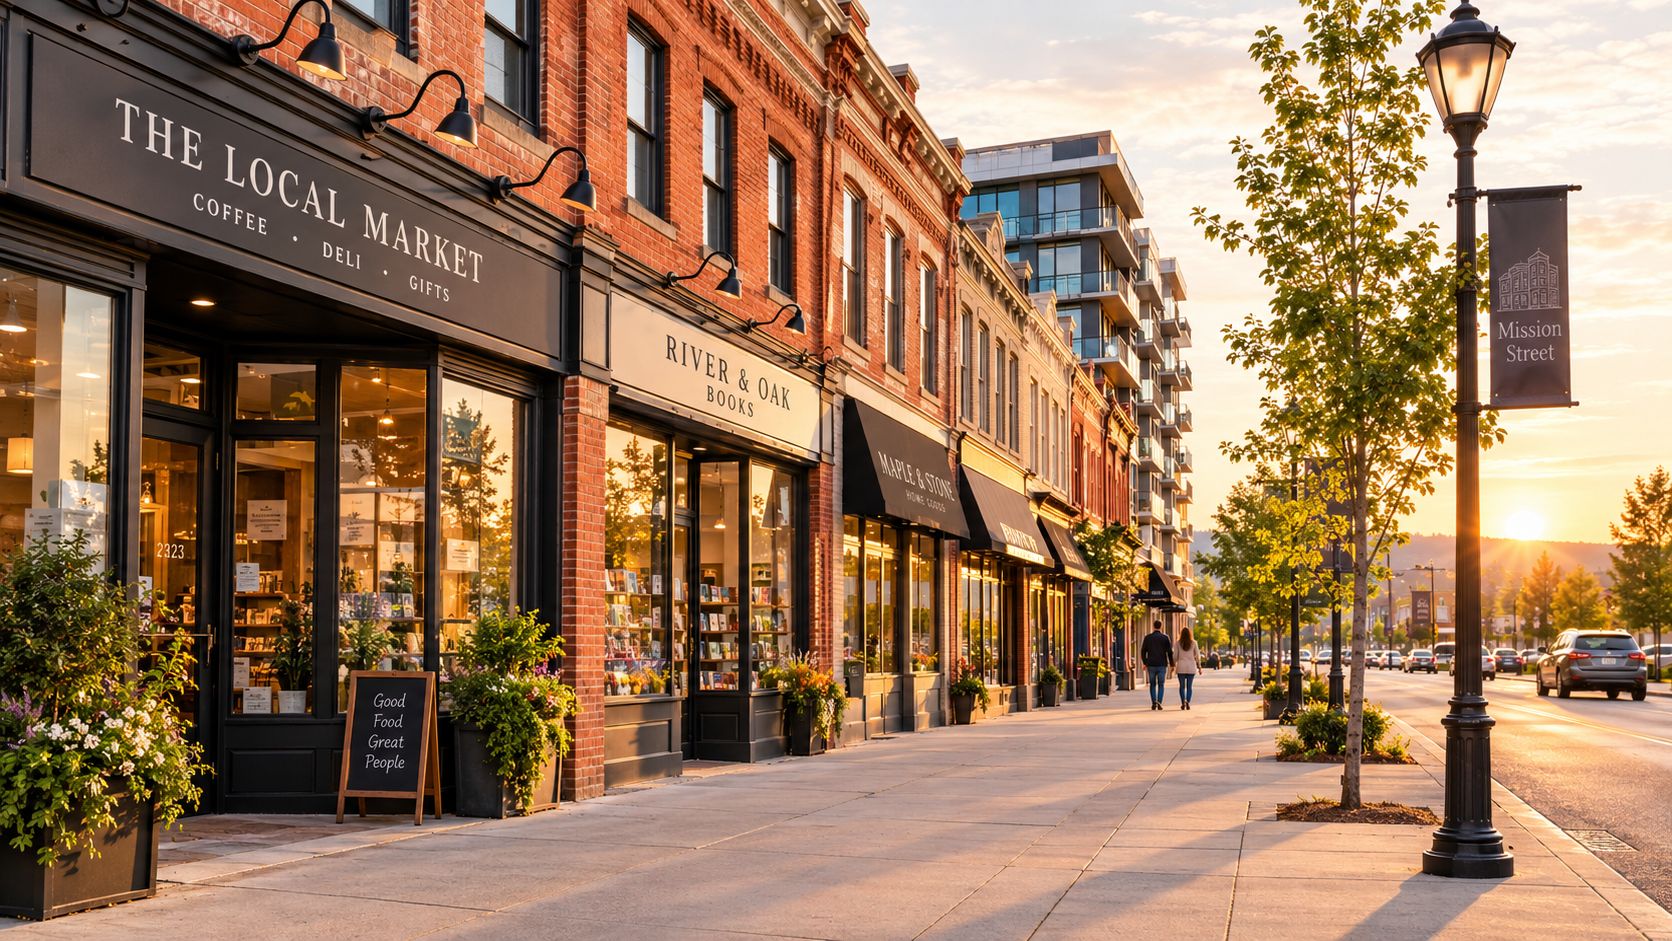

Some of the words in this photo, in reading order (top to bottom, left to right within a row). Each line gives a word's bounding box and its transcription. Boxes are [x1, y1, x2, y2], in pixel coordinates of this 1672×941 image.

[115, 97, 203, 171] THE
[224, 143, 346, 229] LOCAL
[363, 203, 483, 284] MARKET
[193, 193, 268, 236] COFFEE
[322, 241, 361, 271] DELI
[409, 275, 450, 302] GIFTS
[1498, 320, 1562, 340] Mission
[1506, 344, 1556, 362] Street
[666, 334, 729, 384] RIVER
[738, 368, 749, 393] &
[758, 377, 790, 410] OAK
[707, 384, 754, 418] BOOKS
[878, 450, 915, 486] MAPLE
[915, 467, 926, 490] &
[925, 472, 955, 501] STONE
[156, 542, 185, 560] 2323
[373, 692, 407, 709] Good
[373, 713, 404, 728] Food
[368, 734, 405, 750] Great
[365, 754, 405, 774] People
